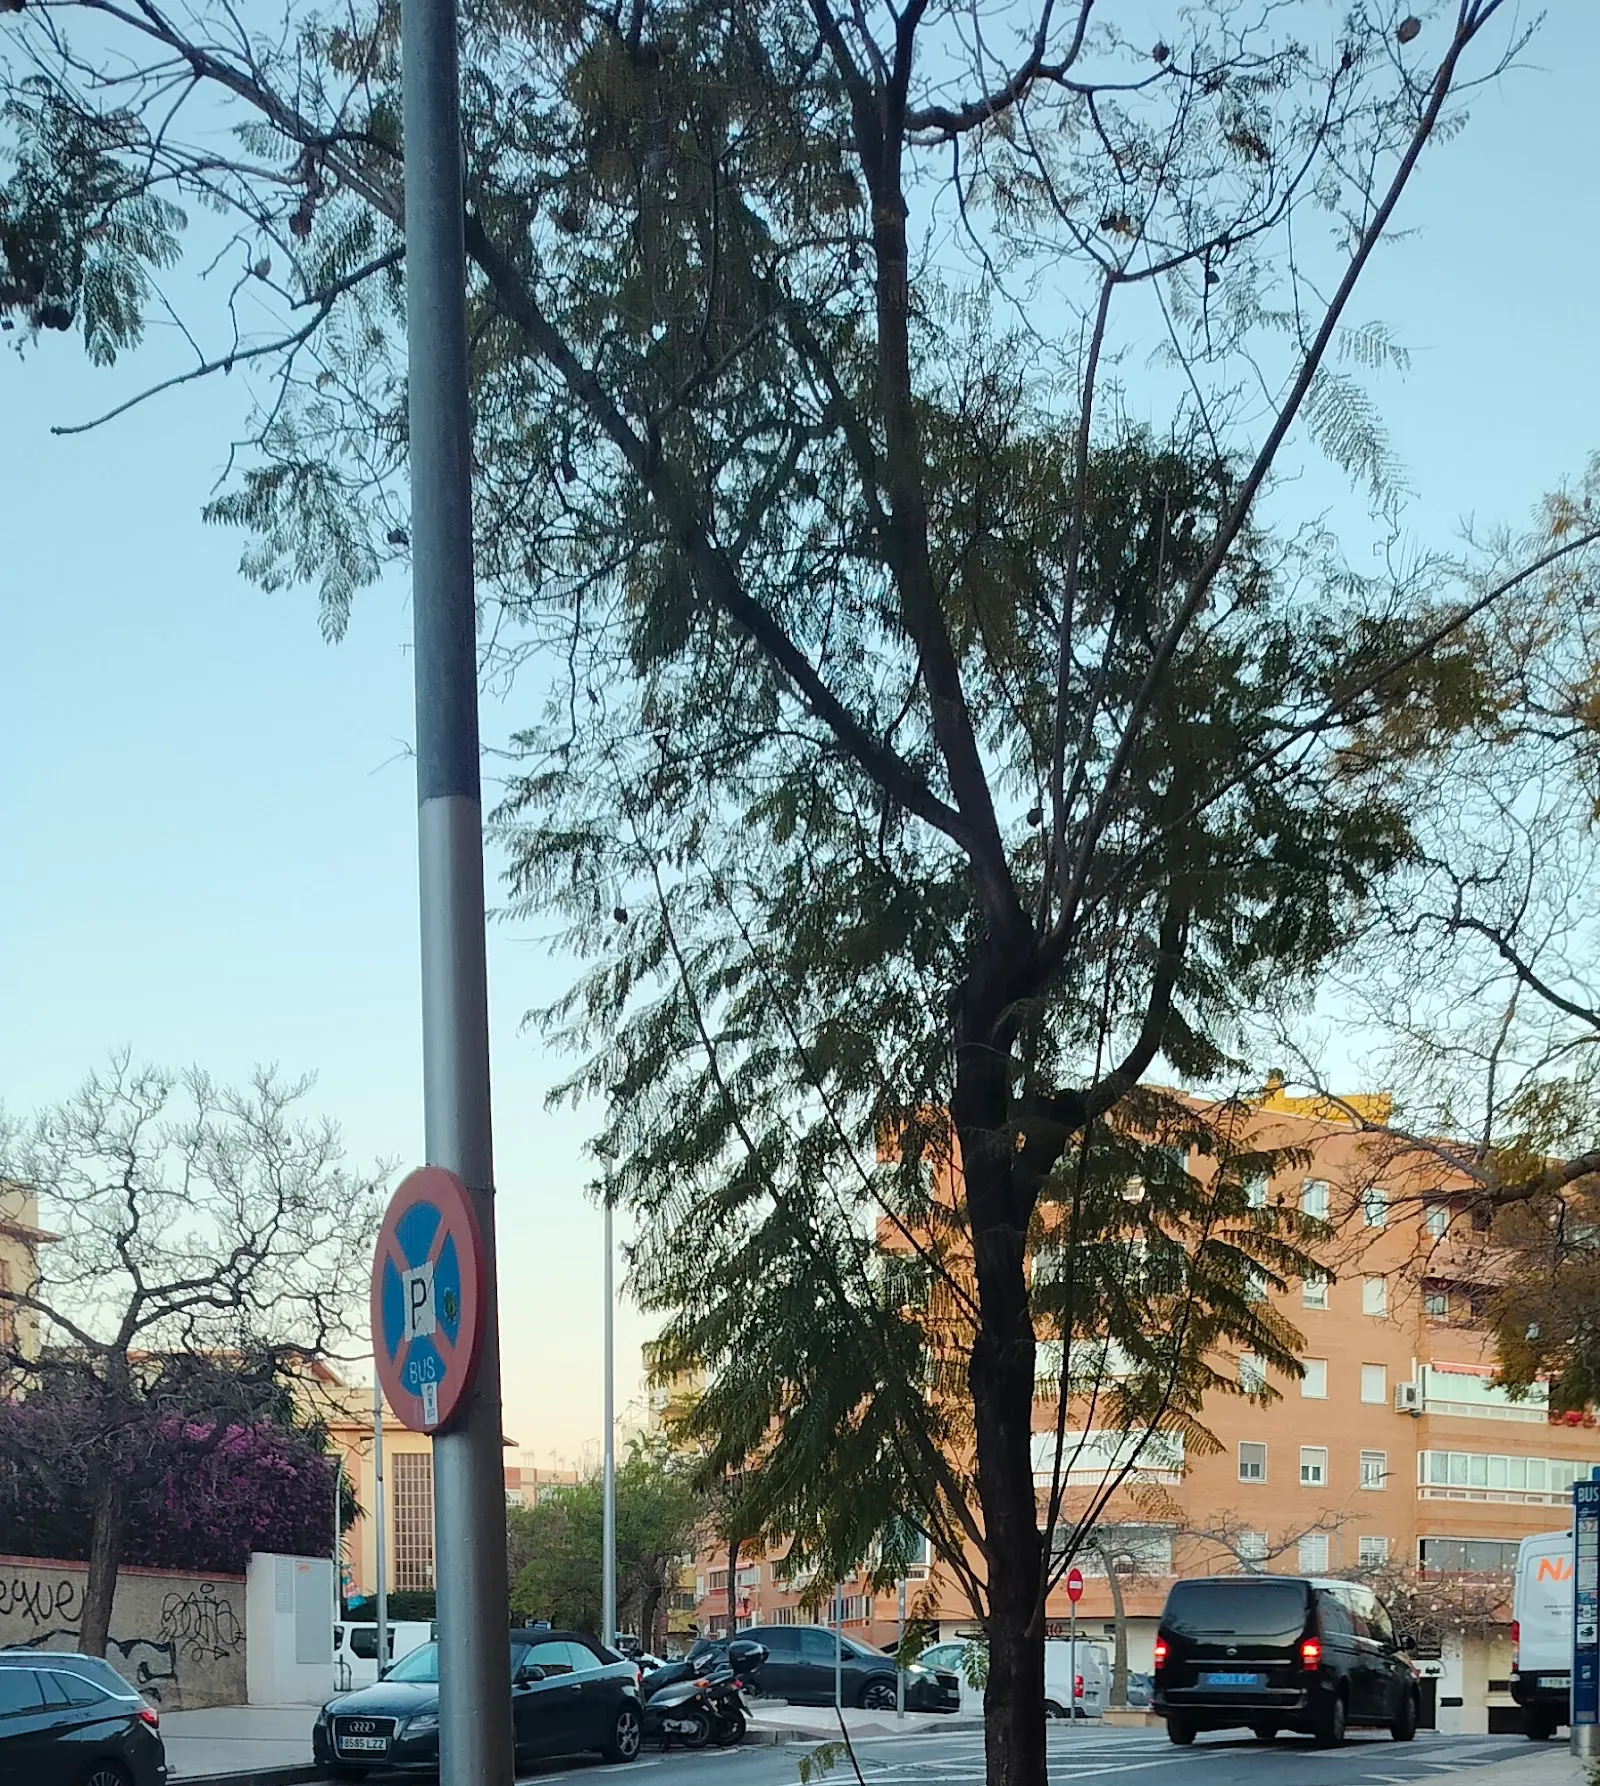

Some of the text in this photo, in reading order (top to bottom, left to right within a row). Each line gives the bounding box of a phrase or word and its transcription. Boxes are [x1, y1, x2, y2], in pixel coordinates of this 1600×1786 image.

[410, 1277, 427, 1330] P
[410, 1356, 435, 1384] BUS
[1578, 1486, 1600, 1503] BUS
[366, 1739, 384, 1749] LZZ
